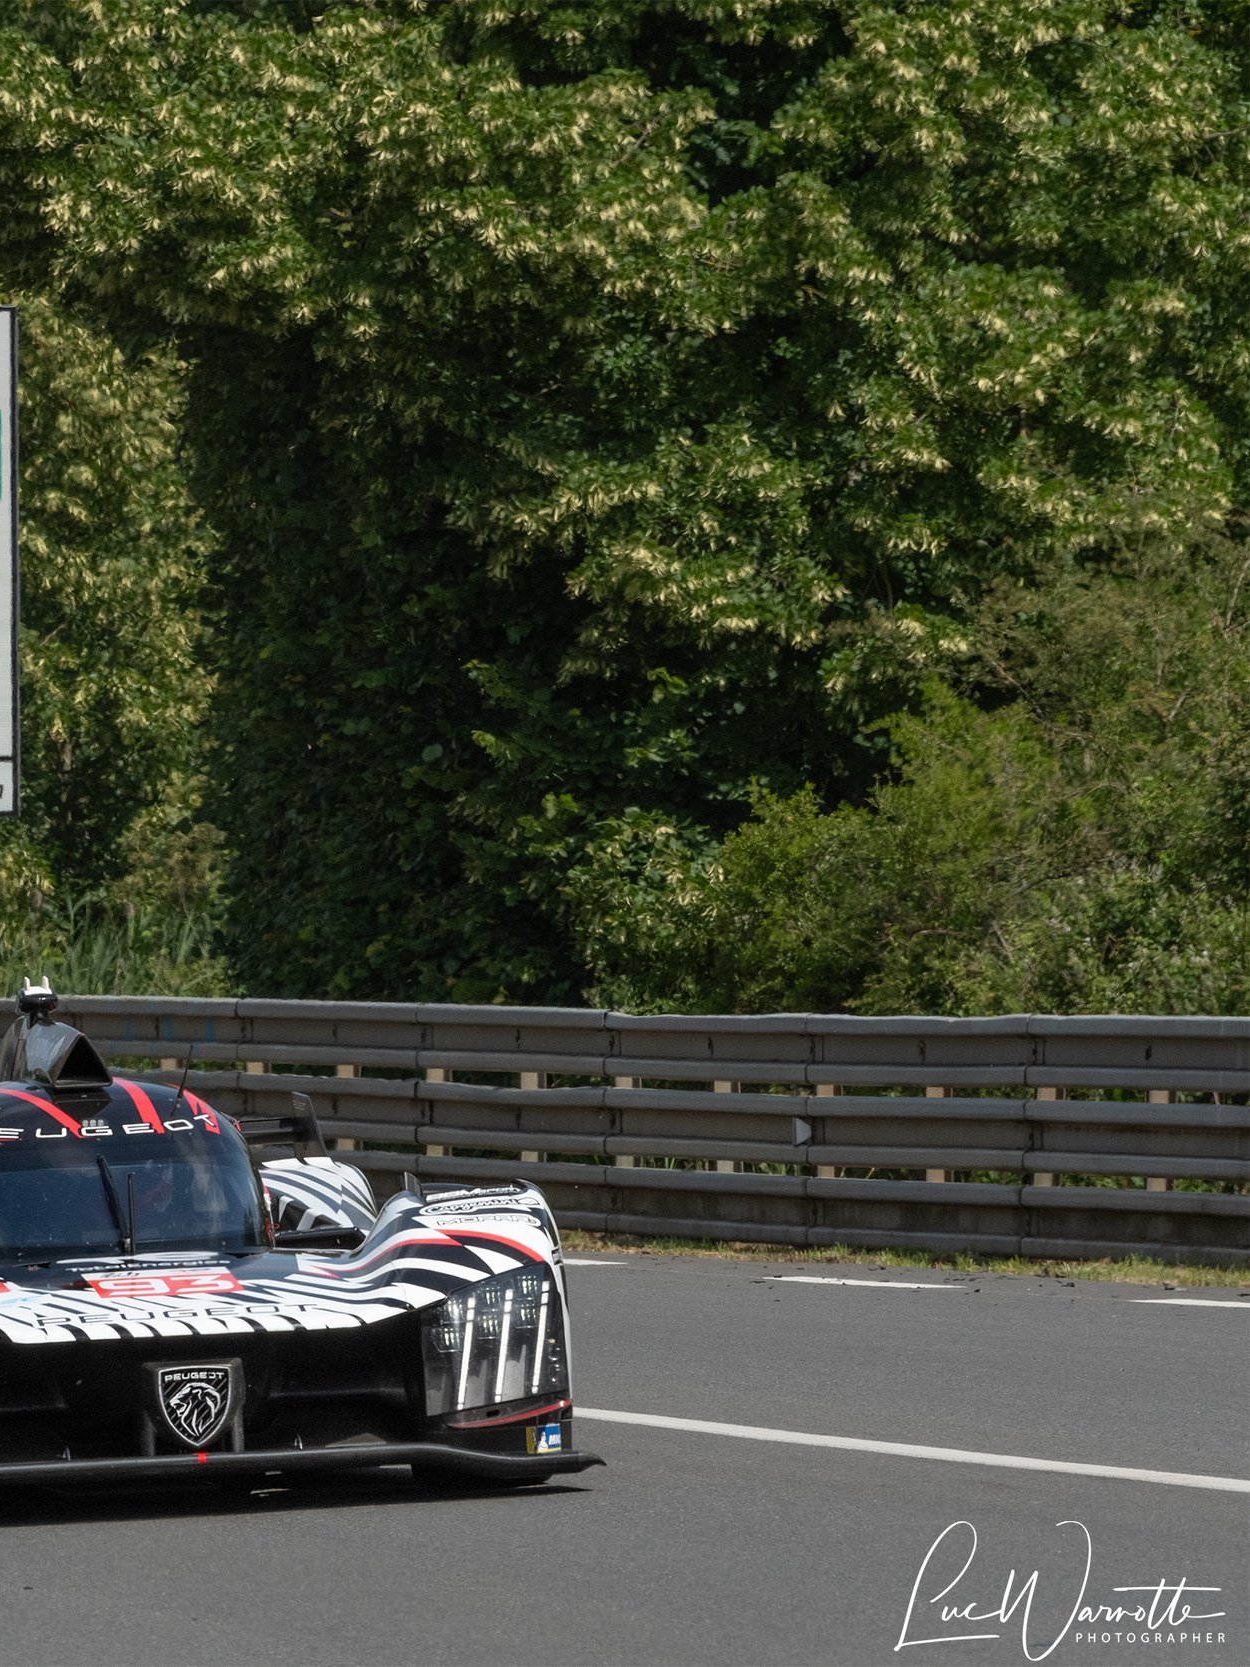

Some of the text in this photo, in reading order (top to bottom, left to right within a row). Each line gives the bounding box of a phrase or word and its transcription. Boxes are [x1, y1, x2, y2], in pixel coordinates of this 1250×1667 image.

[97, 1274, 235, 1296] 93
[36, 1304, 318, 1327] PEUGEOT
[164, 1371, 225, 1383] PEUGEOT
